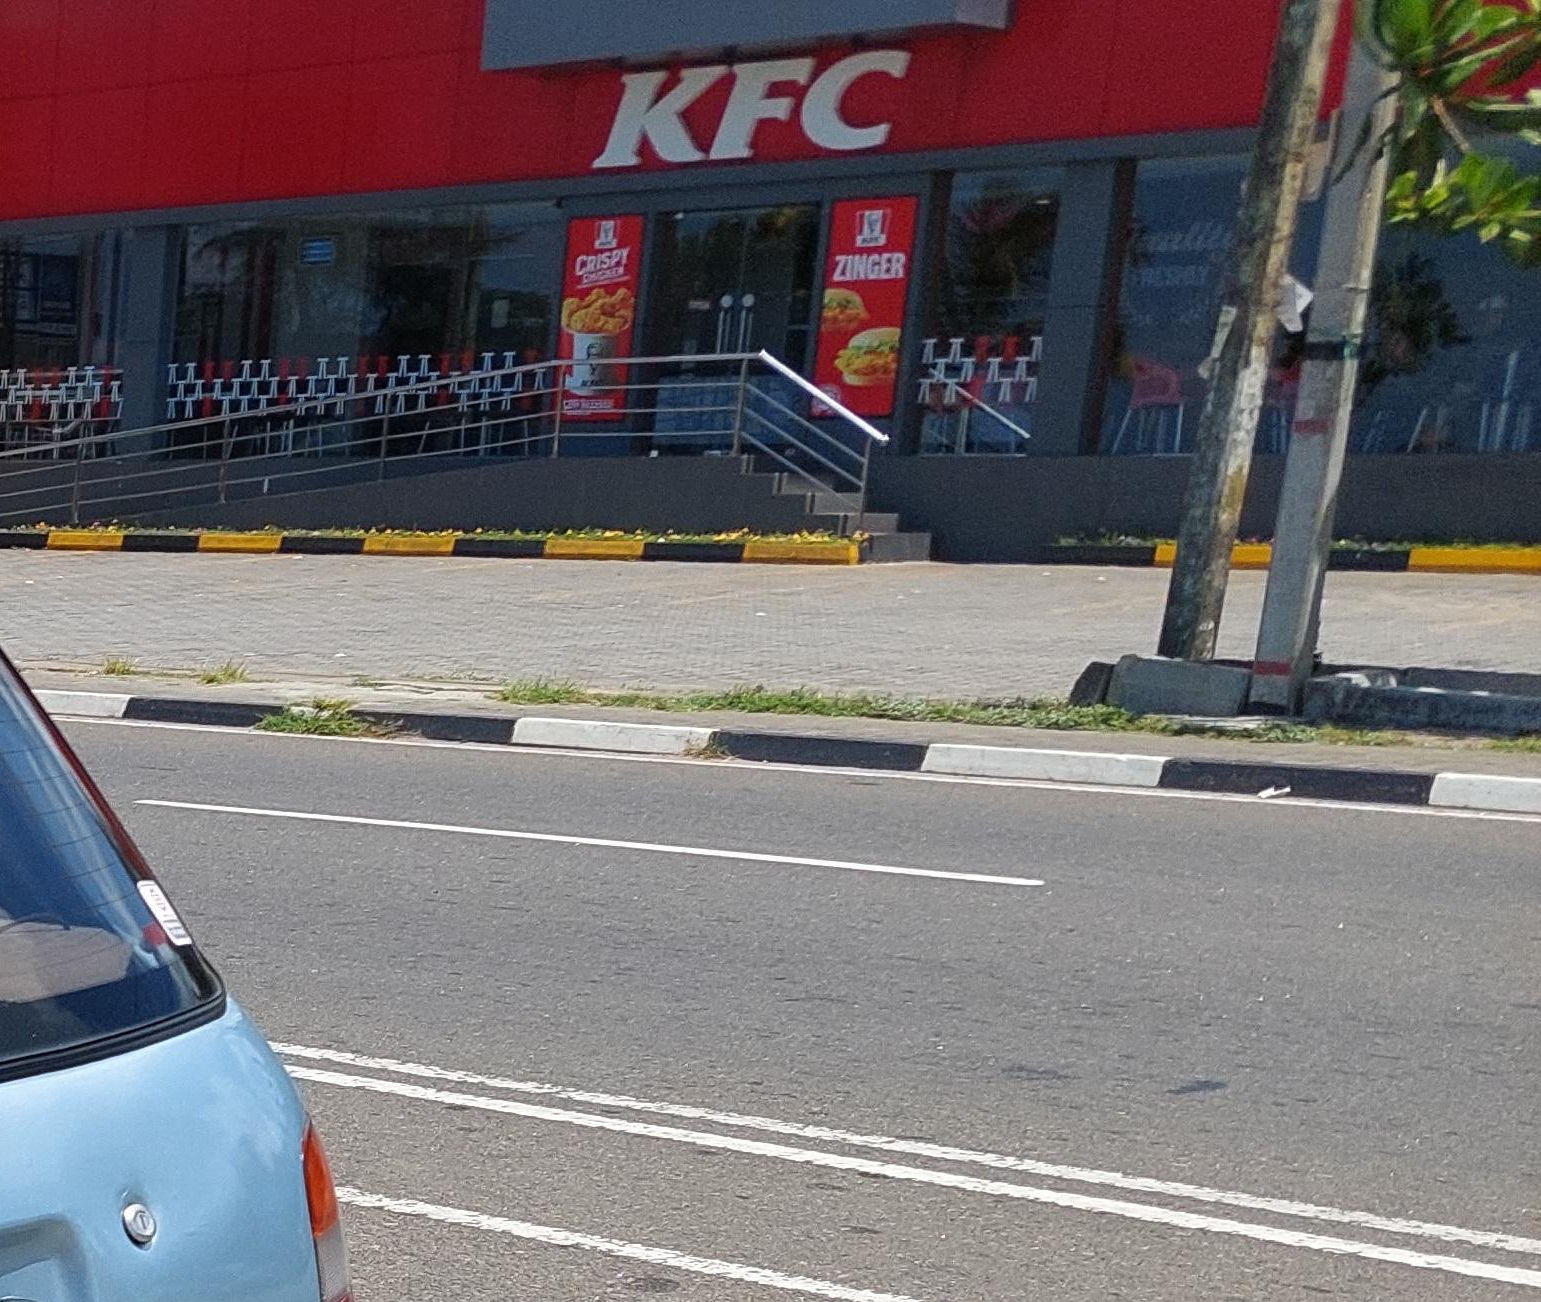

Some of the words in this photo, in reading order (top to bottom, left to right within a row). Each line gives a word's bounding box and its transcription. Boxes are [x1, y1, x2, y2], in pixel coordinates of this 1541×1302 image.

[592, 50, 911, 168] KFC
[574, 246, 631, 276] CRISPY
[833, 252, 906, 281] ZINGER
